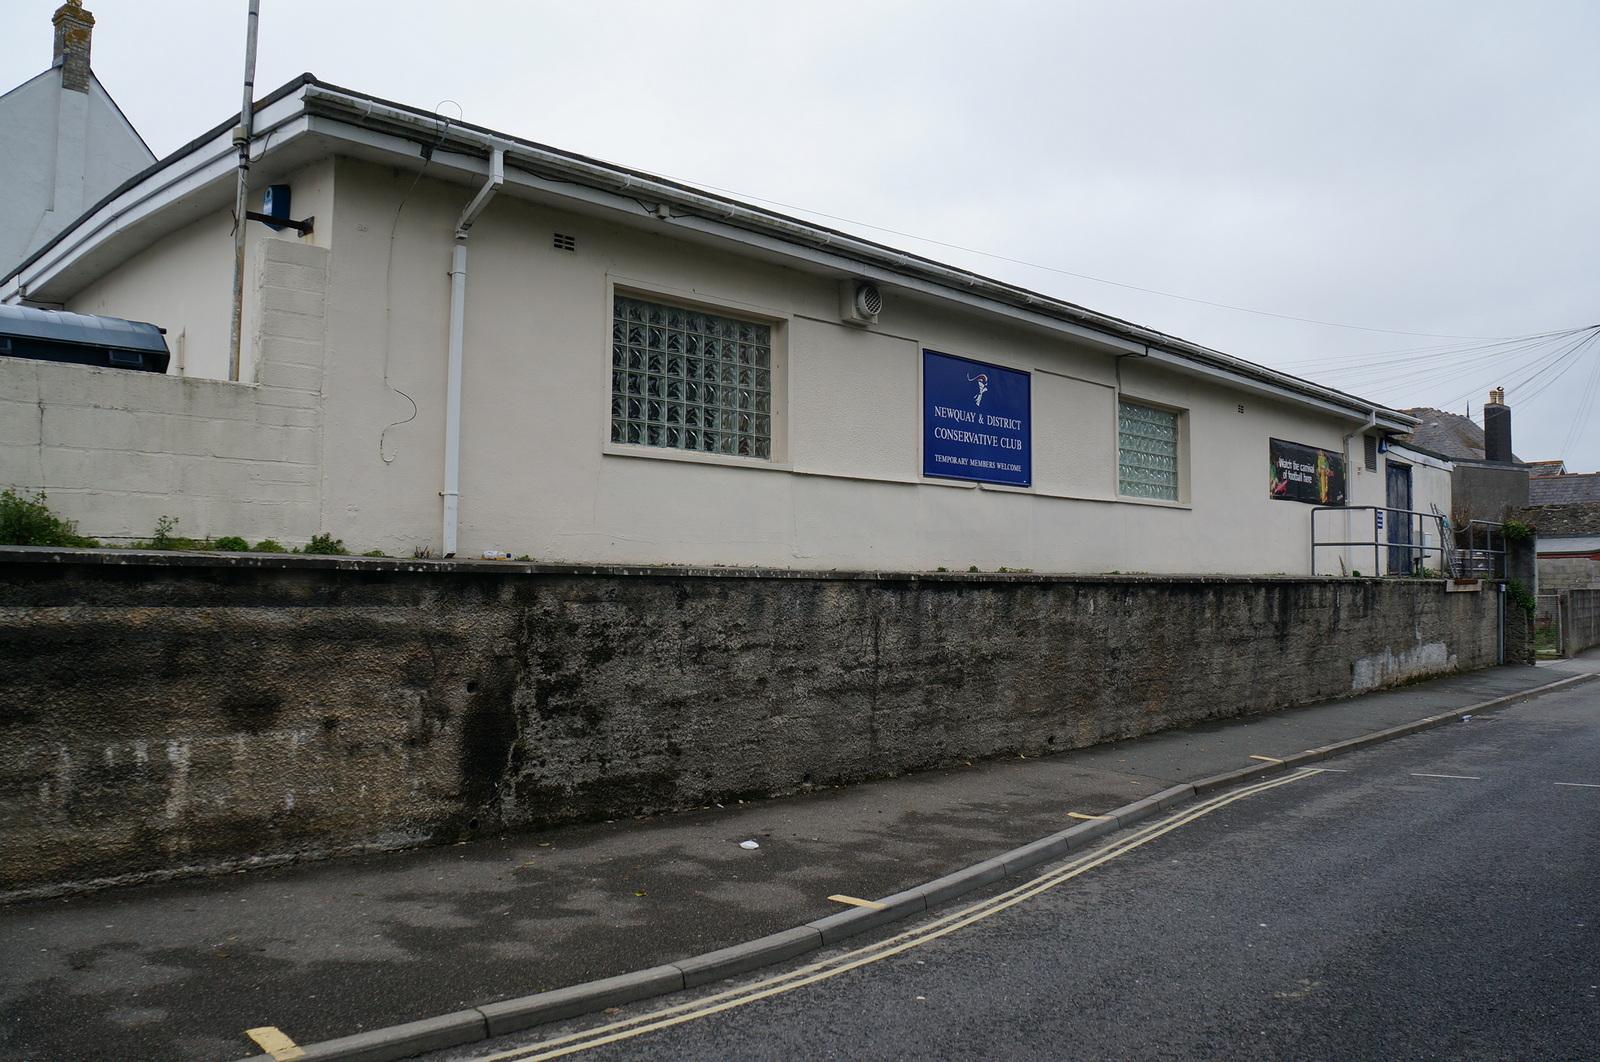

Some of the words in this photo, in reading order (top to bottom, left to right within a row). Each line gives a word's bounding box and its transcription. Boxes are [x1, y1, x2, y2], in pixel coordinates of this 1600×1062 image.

[934, 406, 976, 423] NEWQUAY
[978, 413, 984, 424] &
[987, 415, 1022, 430] DISTRICT
[934, 427, 998, 446] CONSERVATIVE
[1000, 437, 1022, 450] CLUB
[935, 454, 969, 466] TEMPORARY
[970, 458, 996, 469] MEMBERS
[996, 462, 1022, 472] WELCOME
[1288, 470, 1302, 481] football
